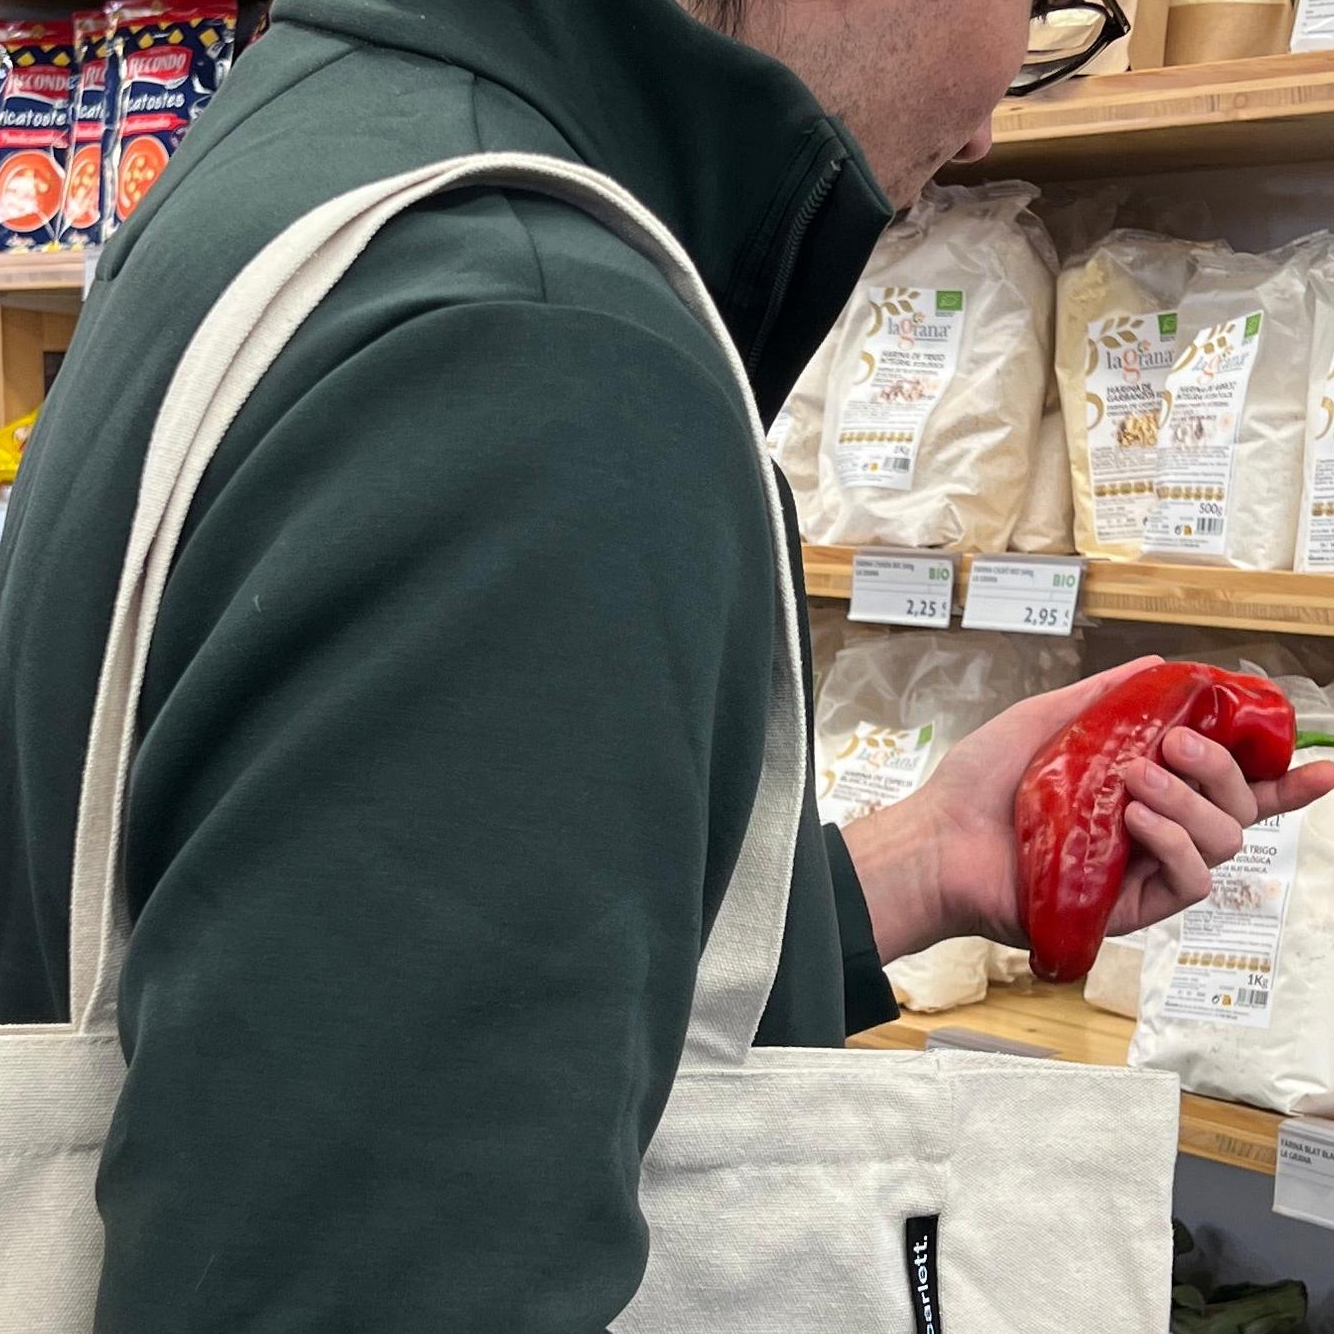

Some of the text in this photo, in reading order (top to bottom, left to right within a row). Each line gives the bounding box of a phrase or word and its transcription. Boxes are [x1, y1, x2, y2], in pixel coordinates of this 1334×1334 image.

[131, 53, 186, 74] RECONDO
[1199, 503, 1223, 516] 500g
[929, 567, 950, 581] BIO
[1052, 574, 1075, 588] BIO
[906, 599, 936, 617] 2,25
[1023, 607, 1058, 627] 2,95
[1250, 845, 1277, 856] TRIGO
[1247, 974, 1268, 989] 1Kg
[1280, 1139, 1304, 1151] FARINA
[1305, 1146, 1321, 1156] BLAT
